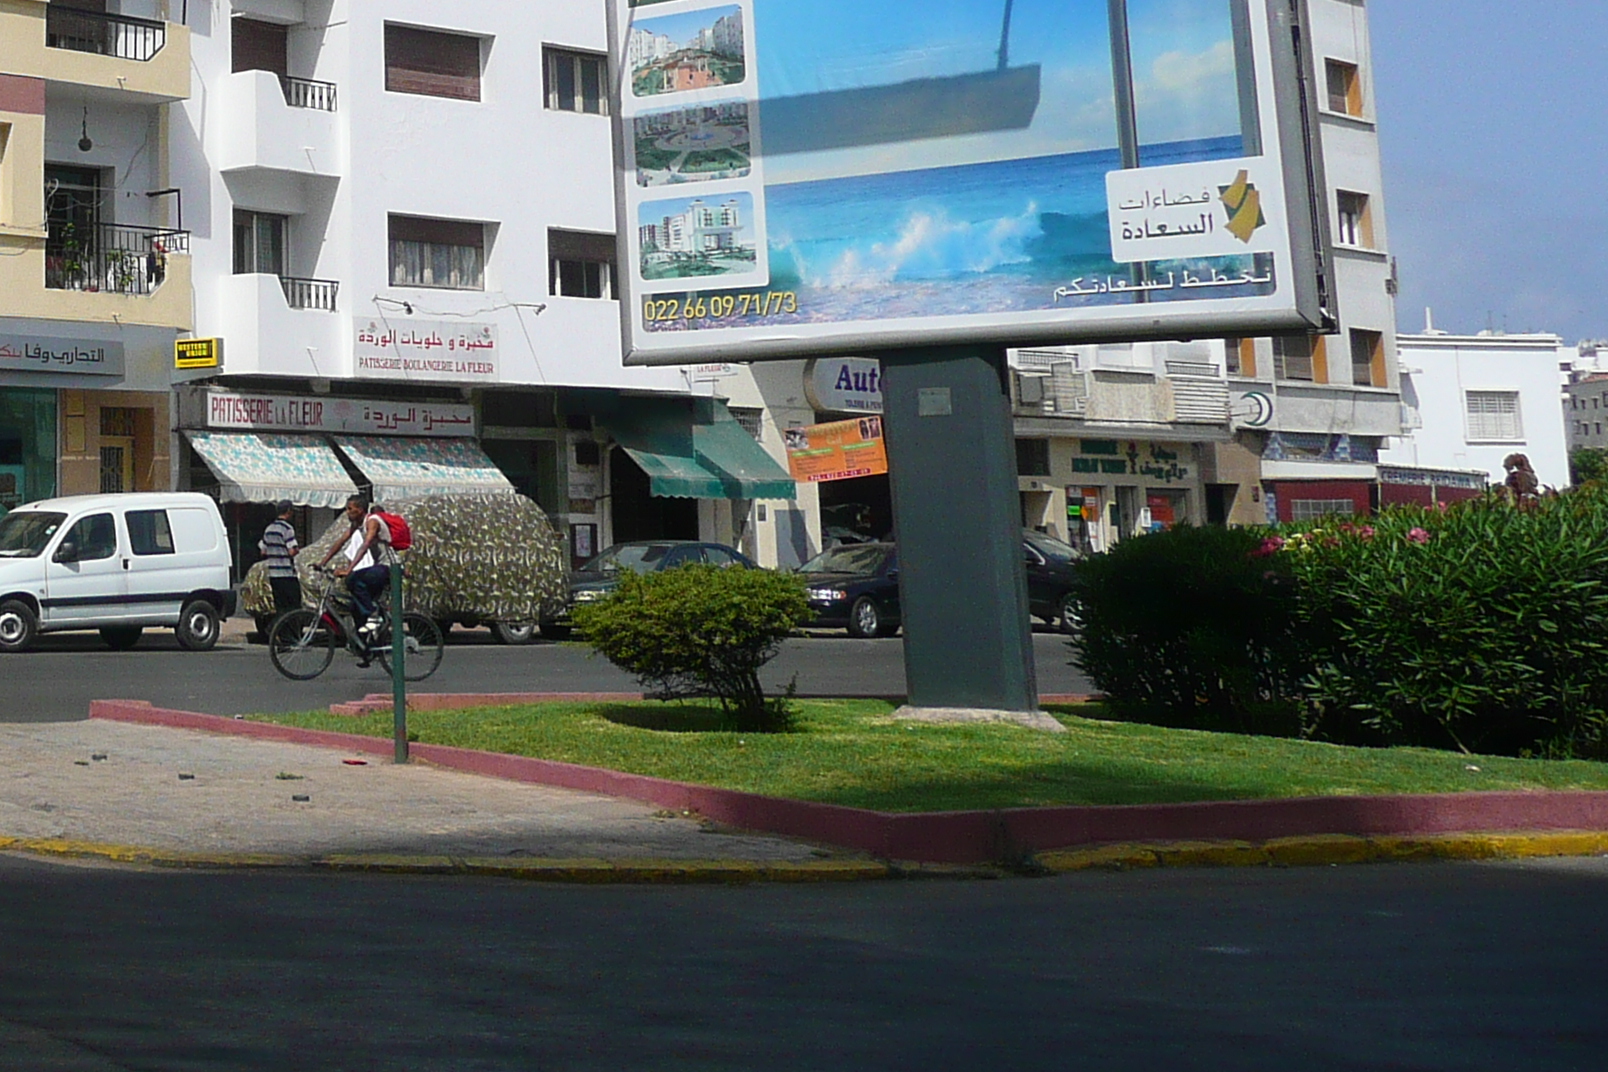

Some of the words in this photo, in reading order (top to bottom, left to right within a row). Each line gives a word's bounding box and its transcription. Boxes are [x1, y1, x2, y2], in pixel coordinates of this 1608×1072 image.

[1118, 187, 1210, 210] فضاءات
[1122, 213, 1213, 240] السعادة
[1053, 272, 1174, 302] لسعادتكم
[1179, 267, 1271, 288] نخطط
[644, 300, 678, 320] 022
[683, 297, 706, 318] 66
[711, 296, 734, 317] 09
[738, 291, 797, 315] 71/73
[359, 329, 397, 347] الوردة
[401, 330, 443, 349] حلويات
[448, 338, 455, 351] و
[459, 334, 494, 351] مخبزة
[25, 343, 50, 363] وفا
[51, 346, 105, 365] التجاري
[359, 357, 401, 370] PATISSERIE
[403, 359, 453, 372] BOULANGERIE
[456, 362, 467, 373] LA
[467, 362, 494, 374] FLEUR
[835, 364, 882, 393] Aut
[212, 397, 273, 424] PATISSERIE
[275, 407, 287, 424] LA
[288, 400, 323, 426] FLEUR
[364, 407, 415, 429] الوردة
